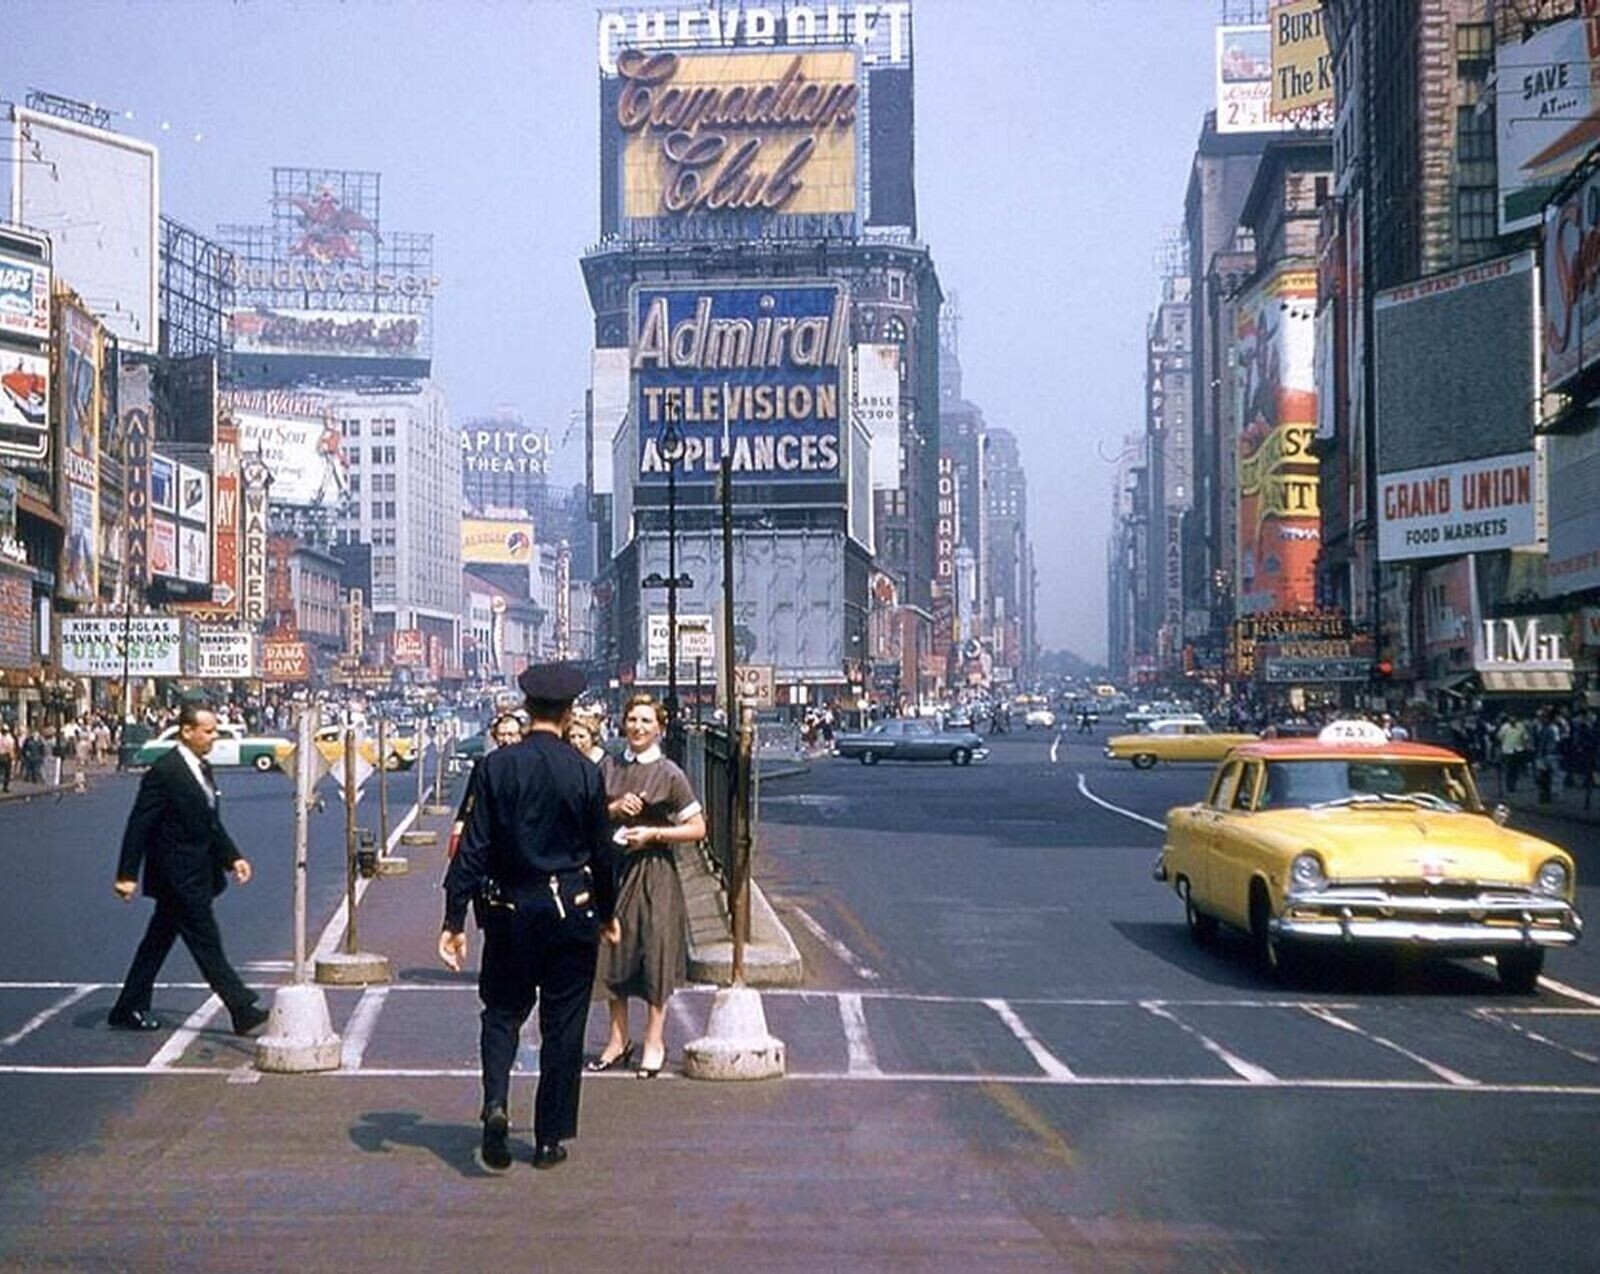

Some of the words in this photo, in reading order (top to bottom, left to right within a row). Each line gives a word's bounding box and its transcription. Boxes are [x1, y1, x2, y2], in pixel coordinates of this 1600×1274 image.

[1278, 9, 1322, 47] BURT
[616, 49, 859, 137] Canadian
[1278, 64, 1314, 100] The
[1318, 54, 1335, 91] K
[1523, 62, 1569, 100] SAVE
[663, 129, 816, 219] Club
[631, 294, 849, 369] Admiral
[643, 384, 838, 422] TELEVISION
[466, 455, 551, 474] THEATRE
[641, 434, 839, 472] APLIANCES
[1384, 476, 1450, 521] GRAND
[1462, 466, 1531, 511] UNION
[938, 458, 952, 577] HOWARD
[1406, 527, 1440, 545] FOOD
[1443, 518, 1508, 542] MARKETS
[247, 493, 264, 619] WARNER
[63, 634, 111, 645] SILVANA
[118, 633, 180, 645] MANGANO
[73, 622, 100, 632] KIRK
[109, 622, 170, 632] DOUGLAS
[73, 643, 171, 660] ULYSES
[734, 669, 760, 684] NO
